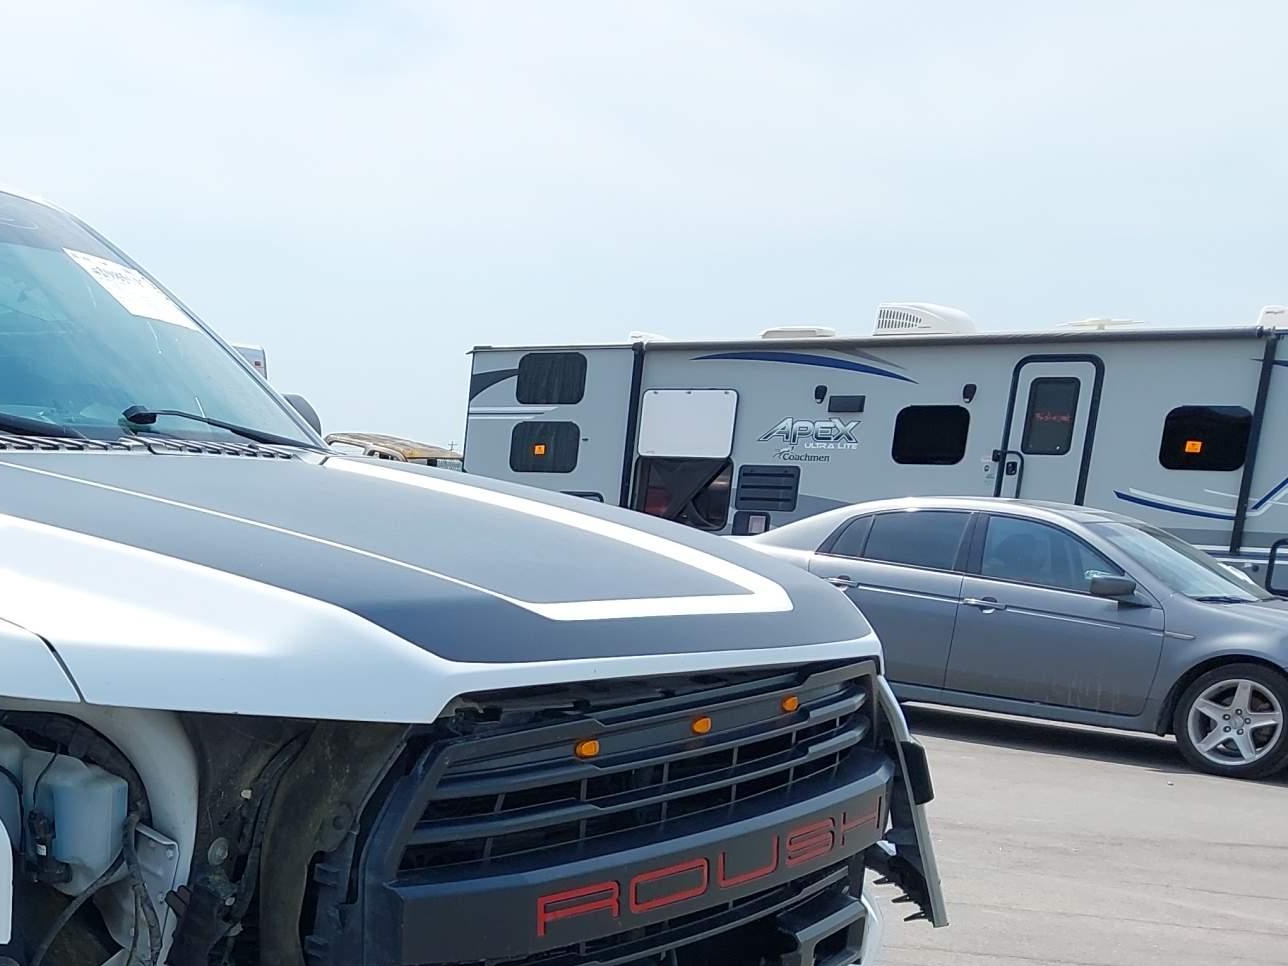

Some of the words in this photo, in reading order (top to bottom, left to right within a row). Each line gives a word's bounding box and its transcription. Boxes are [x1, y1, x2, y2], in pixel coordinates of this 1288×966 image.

[758, 417, 861, 446] APEX
[804, 442, 835, 450] ULTRA
[838, 442, 858, 450] LITE
[782, 451, 830, 462] Coachmen
[536, 797, 883, 938] ROUSH
